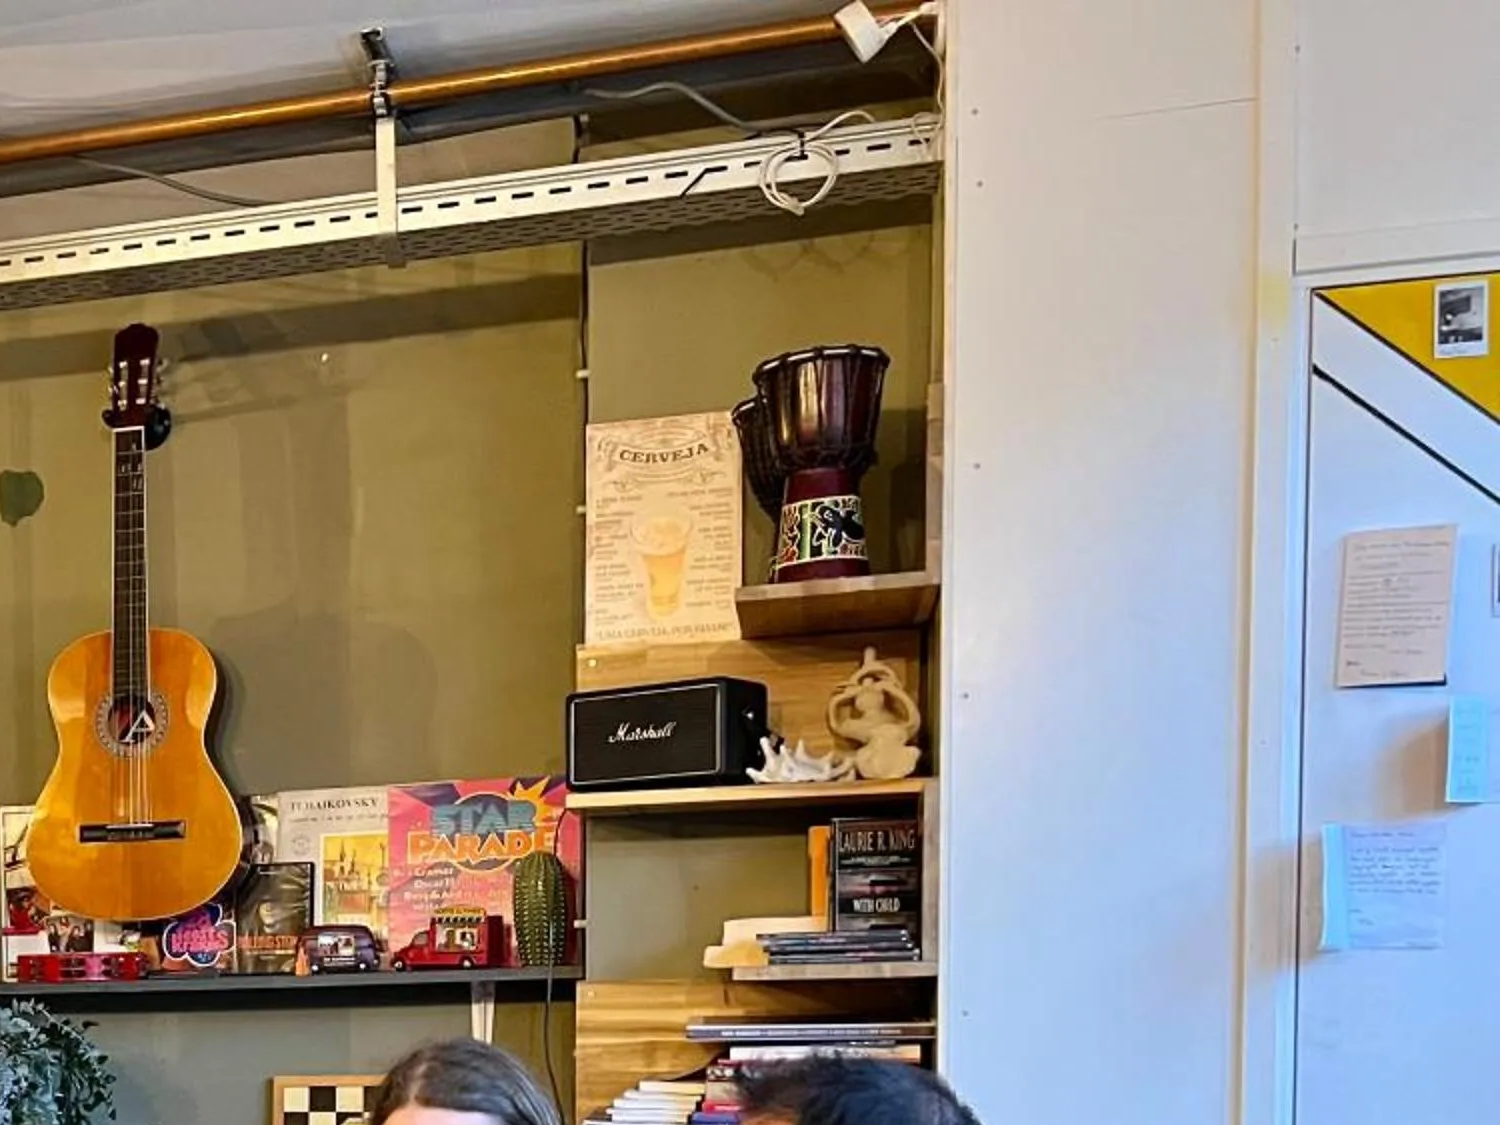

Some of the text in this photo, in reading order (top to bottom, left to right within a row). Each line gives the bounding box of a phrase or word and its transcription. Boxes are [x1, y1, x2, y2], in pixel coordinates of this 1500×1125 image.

[619, 443, 709, 464] CERVEJA
[607, 721, 676, 743] Marshall
[432, 800, 536, 836] STAR
[408, 824, 558, 866] PARADE
[839, 830, 874, 852] LAURIE
[888, 829, 915, 852] KING
[853, 899, 874, 912] WITH
